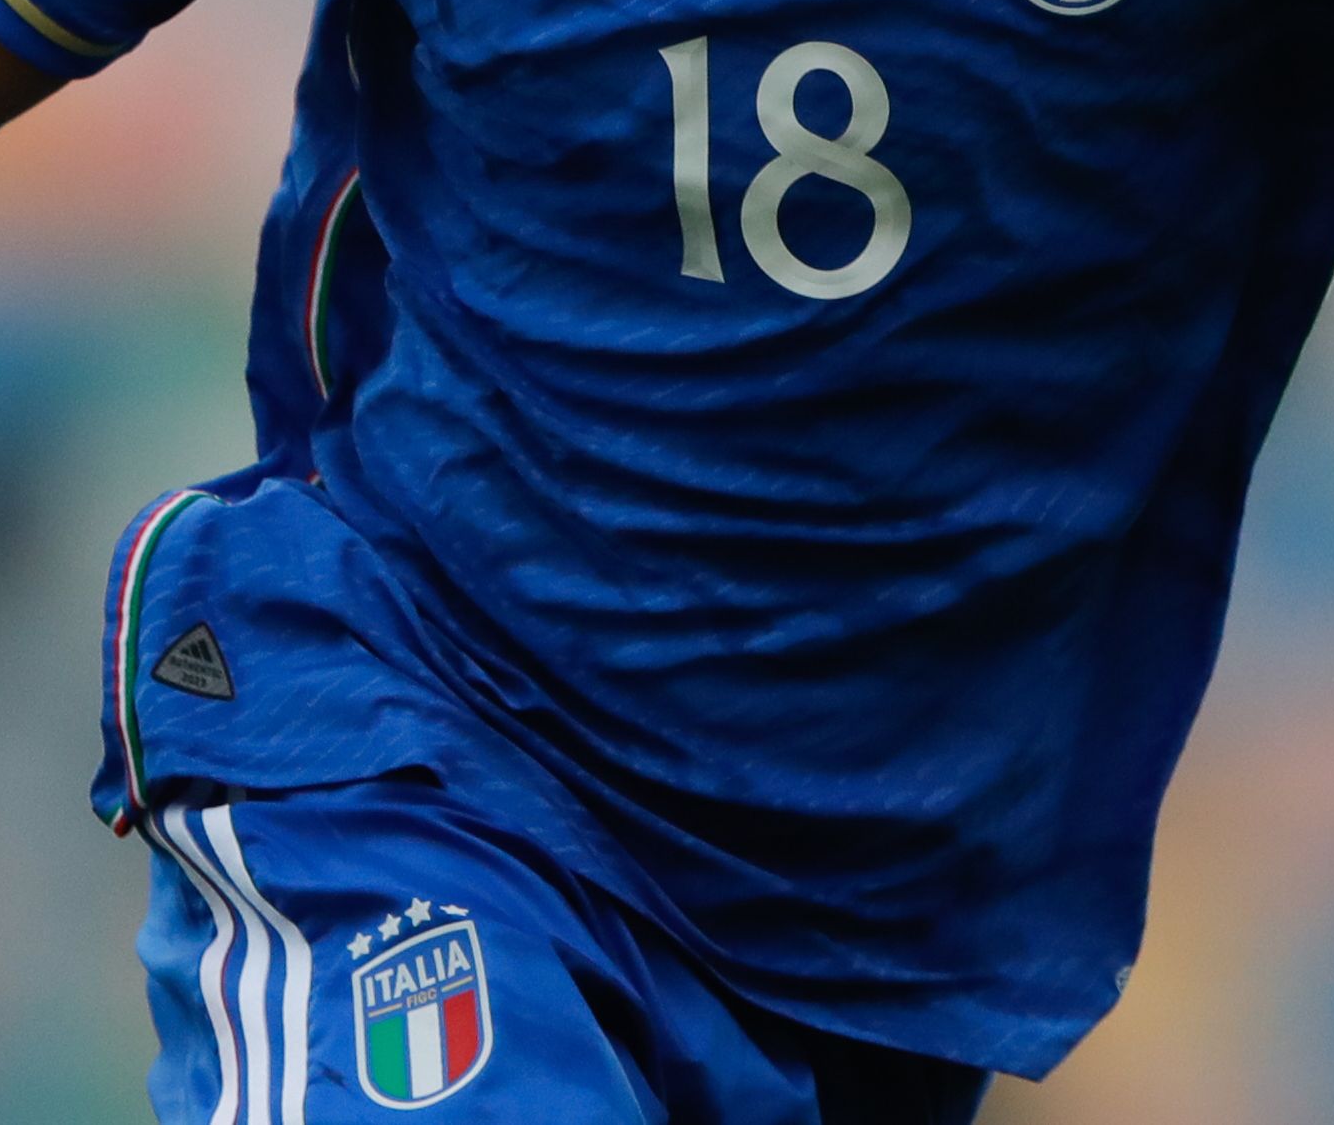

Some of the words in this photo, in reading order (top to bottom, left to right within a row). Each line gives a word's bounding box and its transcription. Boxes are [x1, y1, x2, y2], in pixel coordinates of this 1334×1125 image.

[658, 35, 912, 299] 18
[365, 940, 471, 1007] ITALIA
[406, 988, 437, 1007] FIGC
